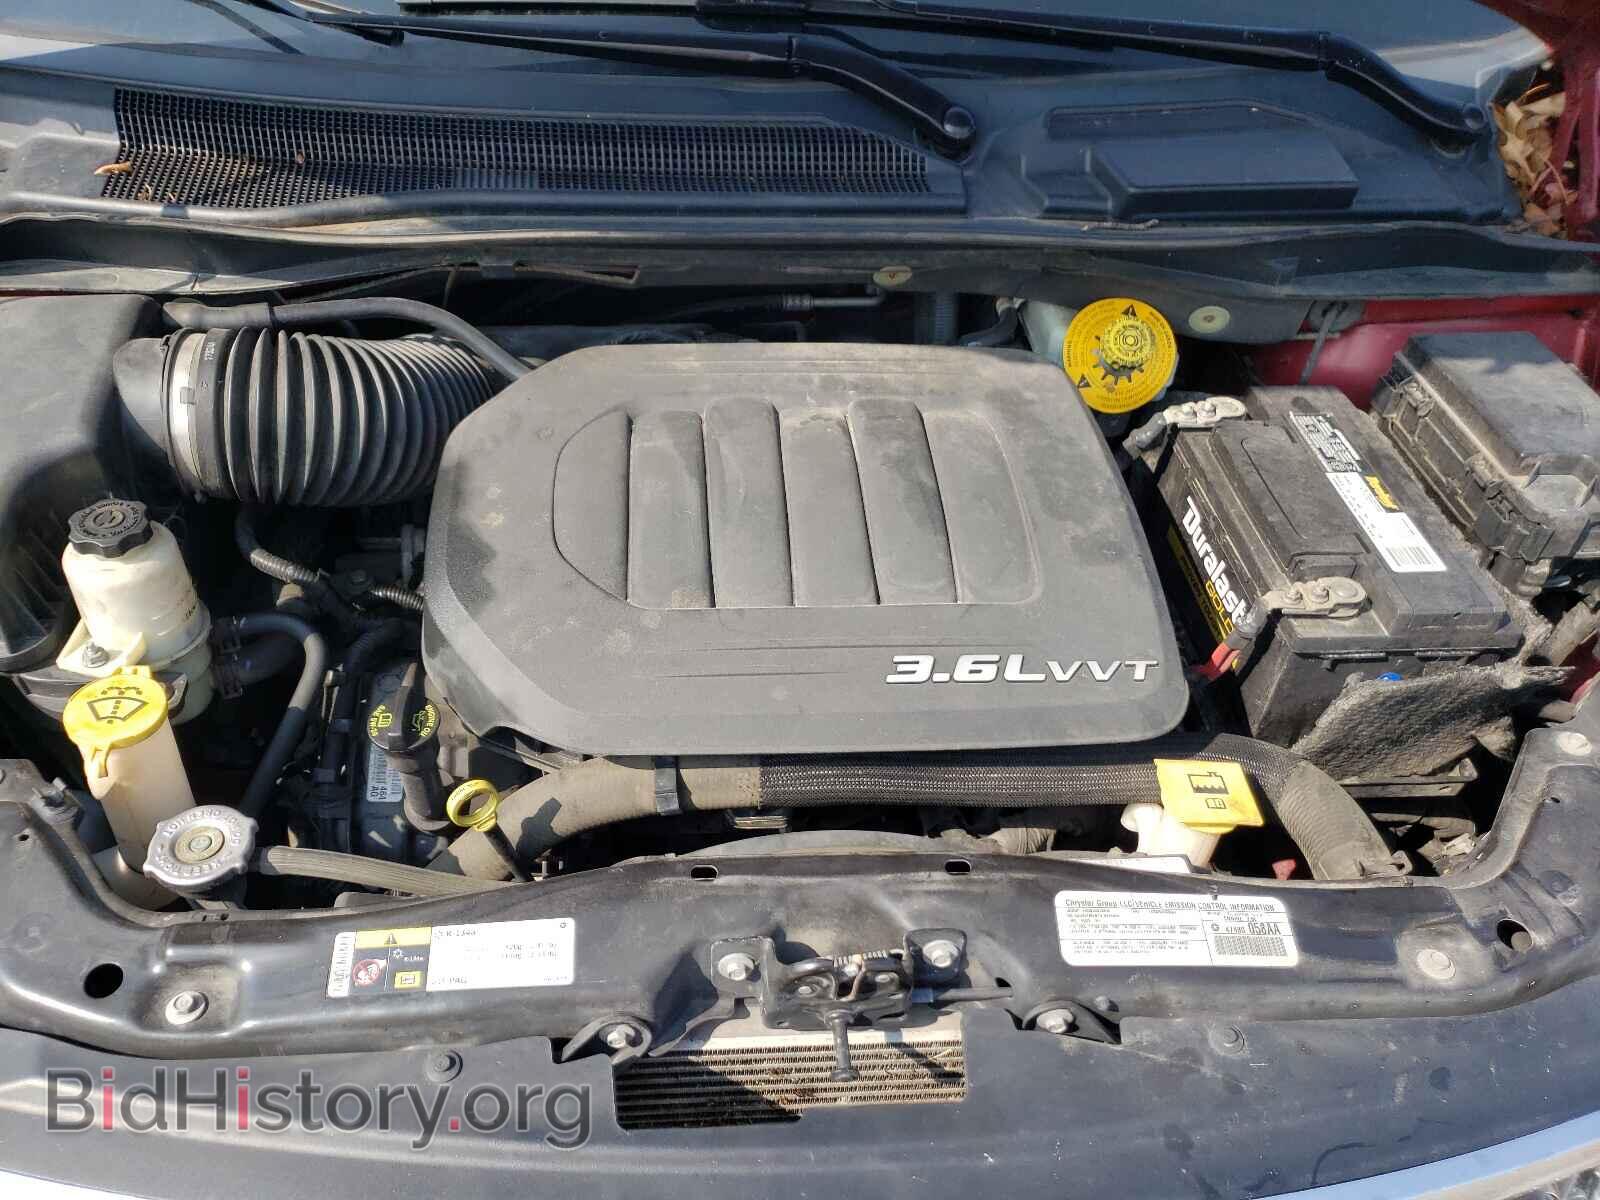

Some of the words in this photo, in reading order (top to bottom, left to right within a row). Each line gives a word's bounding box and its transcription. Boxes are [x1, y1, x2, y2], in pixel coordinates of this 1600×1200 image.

[1182, 495, 1247, 626] Duralast
[1205, 579, 1234, 635] GOLD
[886, 654, 1047, 684] 3.6L
[1046, 660, 1159, 683] VVT
[1096, 899, 1118, 908] Group
[1165, 901, 1196, 910] EMISSION
[1199, 902, 1228, 910] CONTROL
[1229, 903, 1275, 912] INFORMATION
[1248, 922, 1281, 936] 058AA
